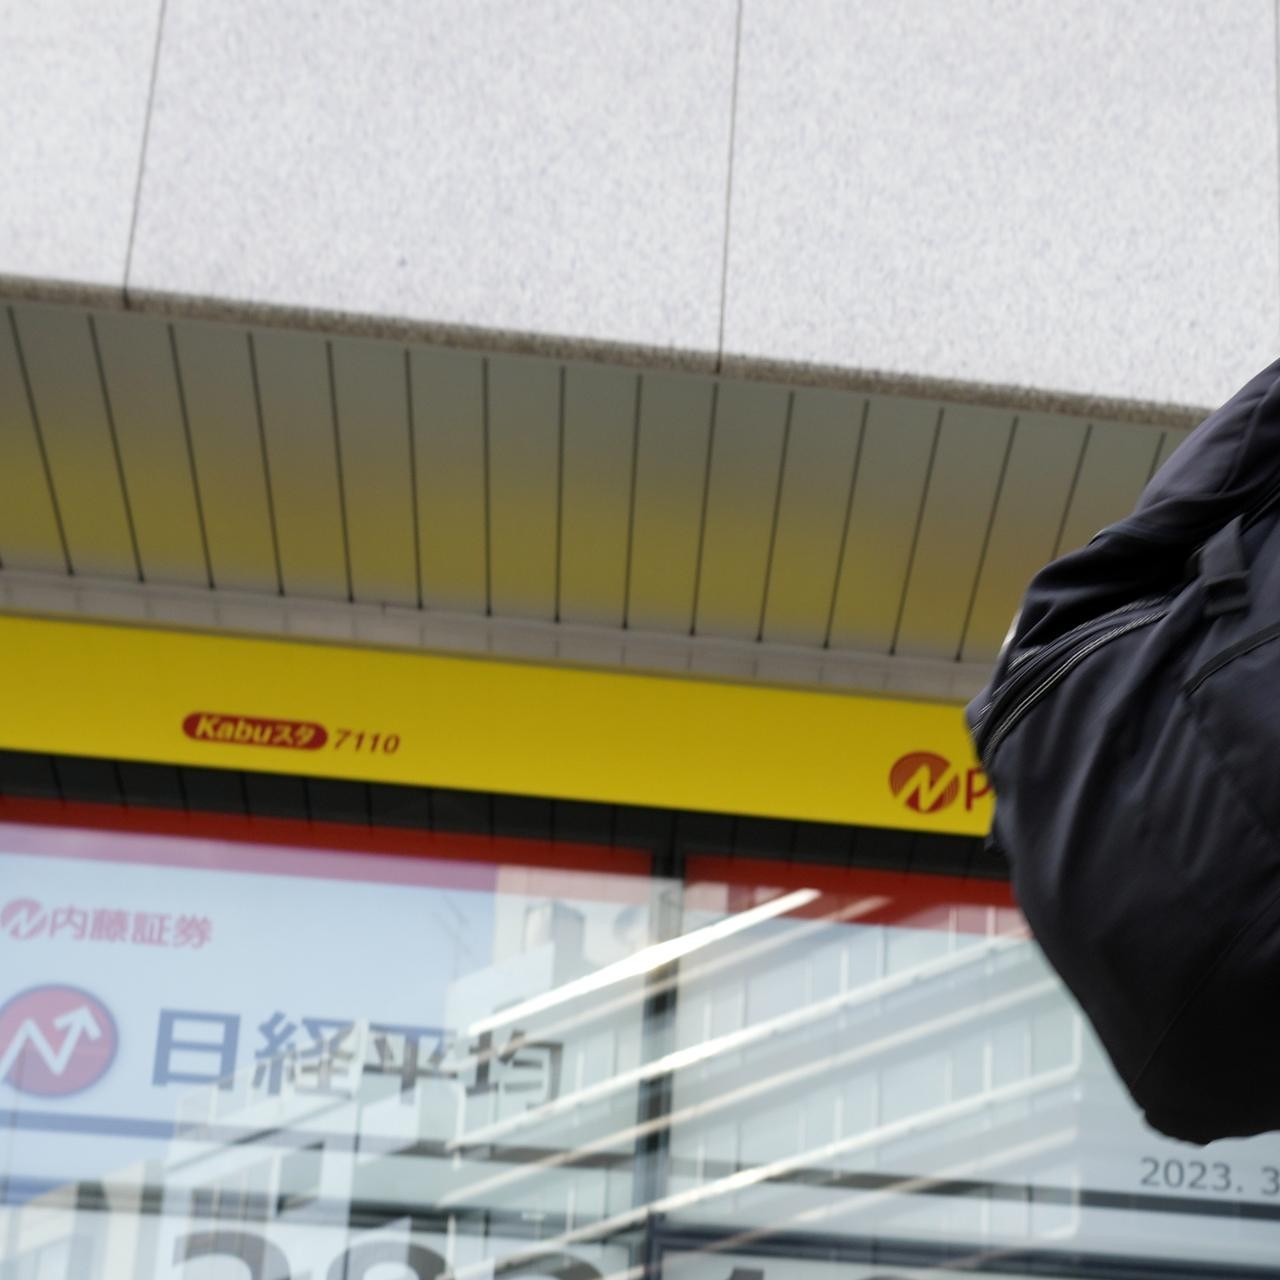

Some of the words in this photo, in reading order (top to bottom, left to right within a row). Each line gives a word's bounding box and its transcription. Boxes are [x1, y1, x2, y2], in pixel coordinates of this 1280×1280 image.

[334, 729, 400, 754] 7110
[49, 905, 213, 950] 内藤証券
[153, 1008, 564, 1110] 日経平均
